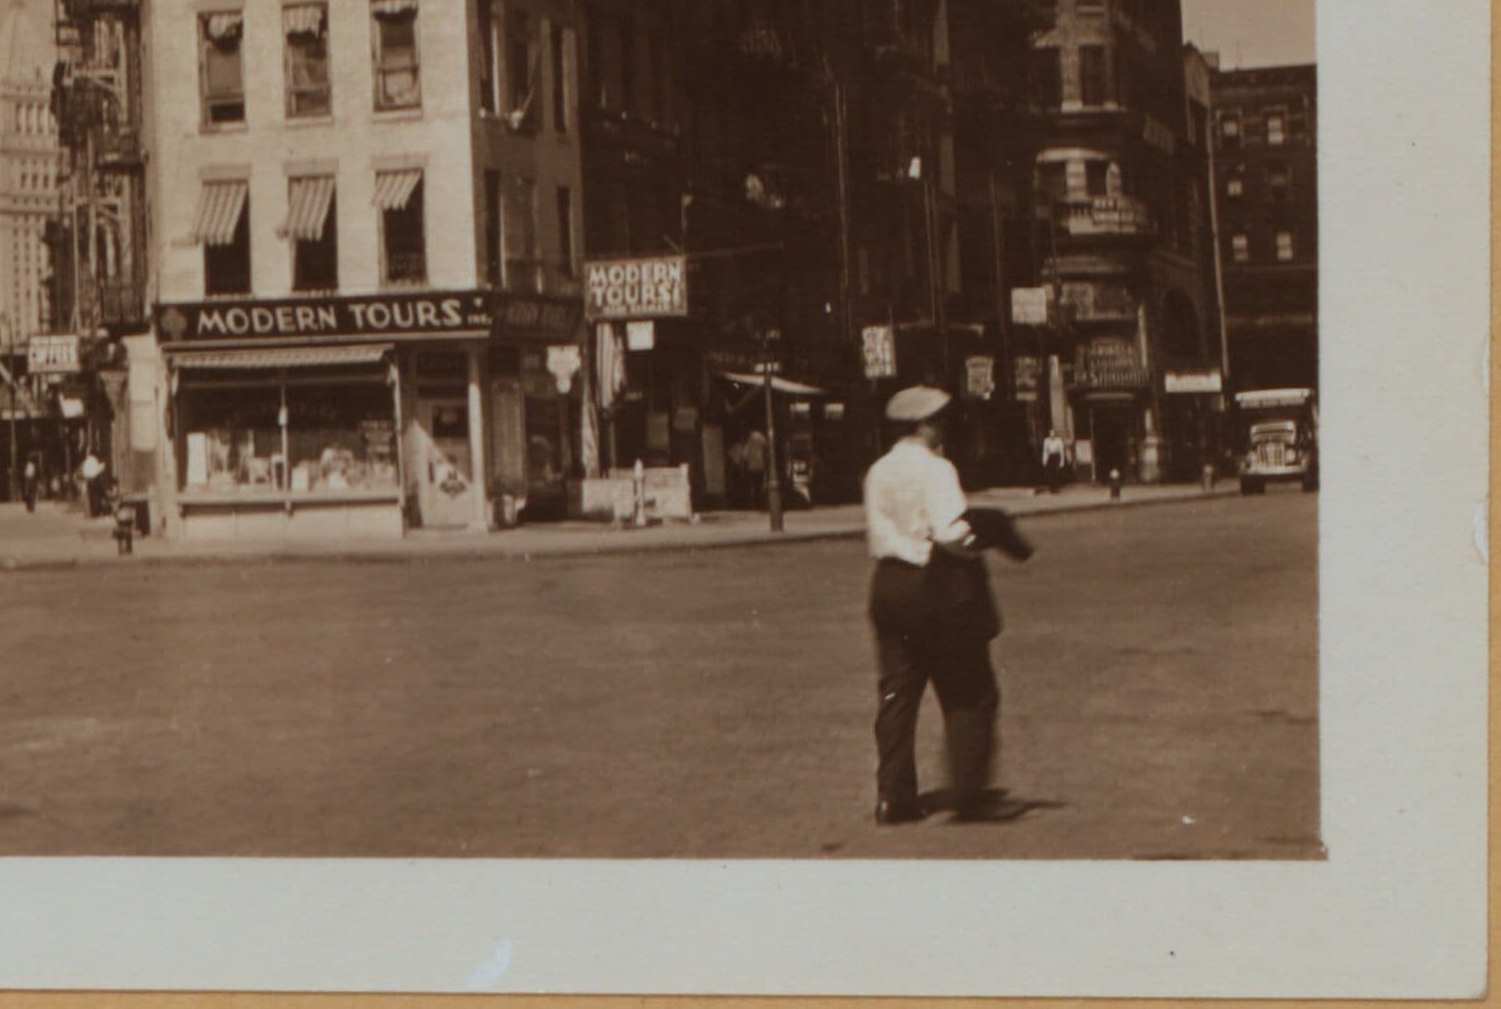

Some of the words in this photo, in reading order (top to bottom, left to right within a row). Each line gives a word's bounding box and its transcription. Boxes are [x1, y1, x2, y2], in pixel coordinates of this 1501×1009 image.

[588, 261, 681, 287] MODERN
[196, 303, 337, 335] MODERN
[347, 298, 462, 330] TOURS
